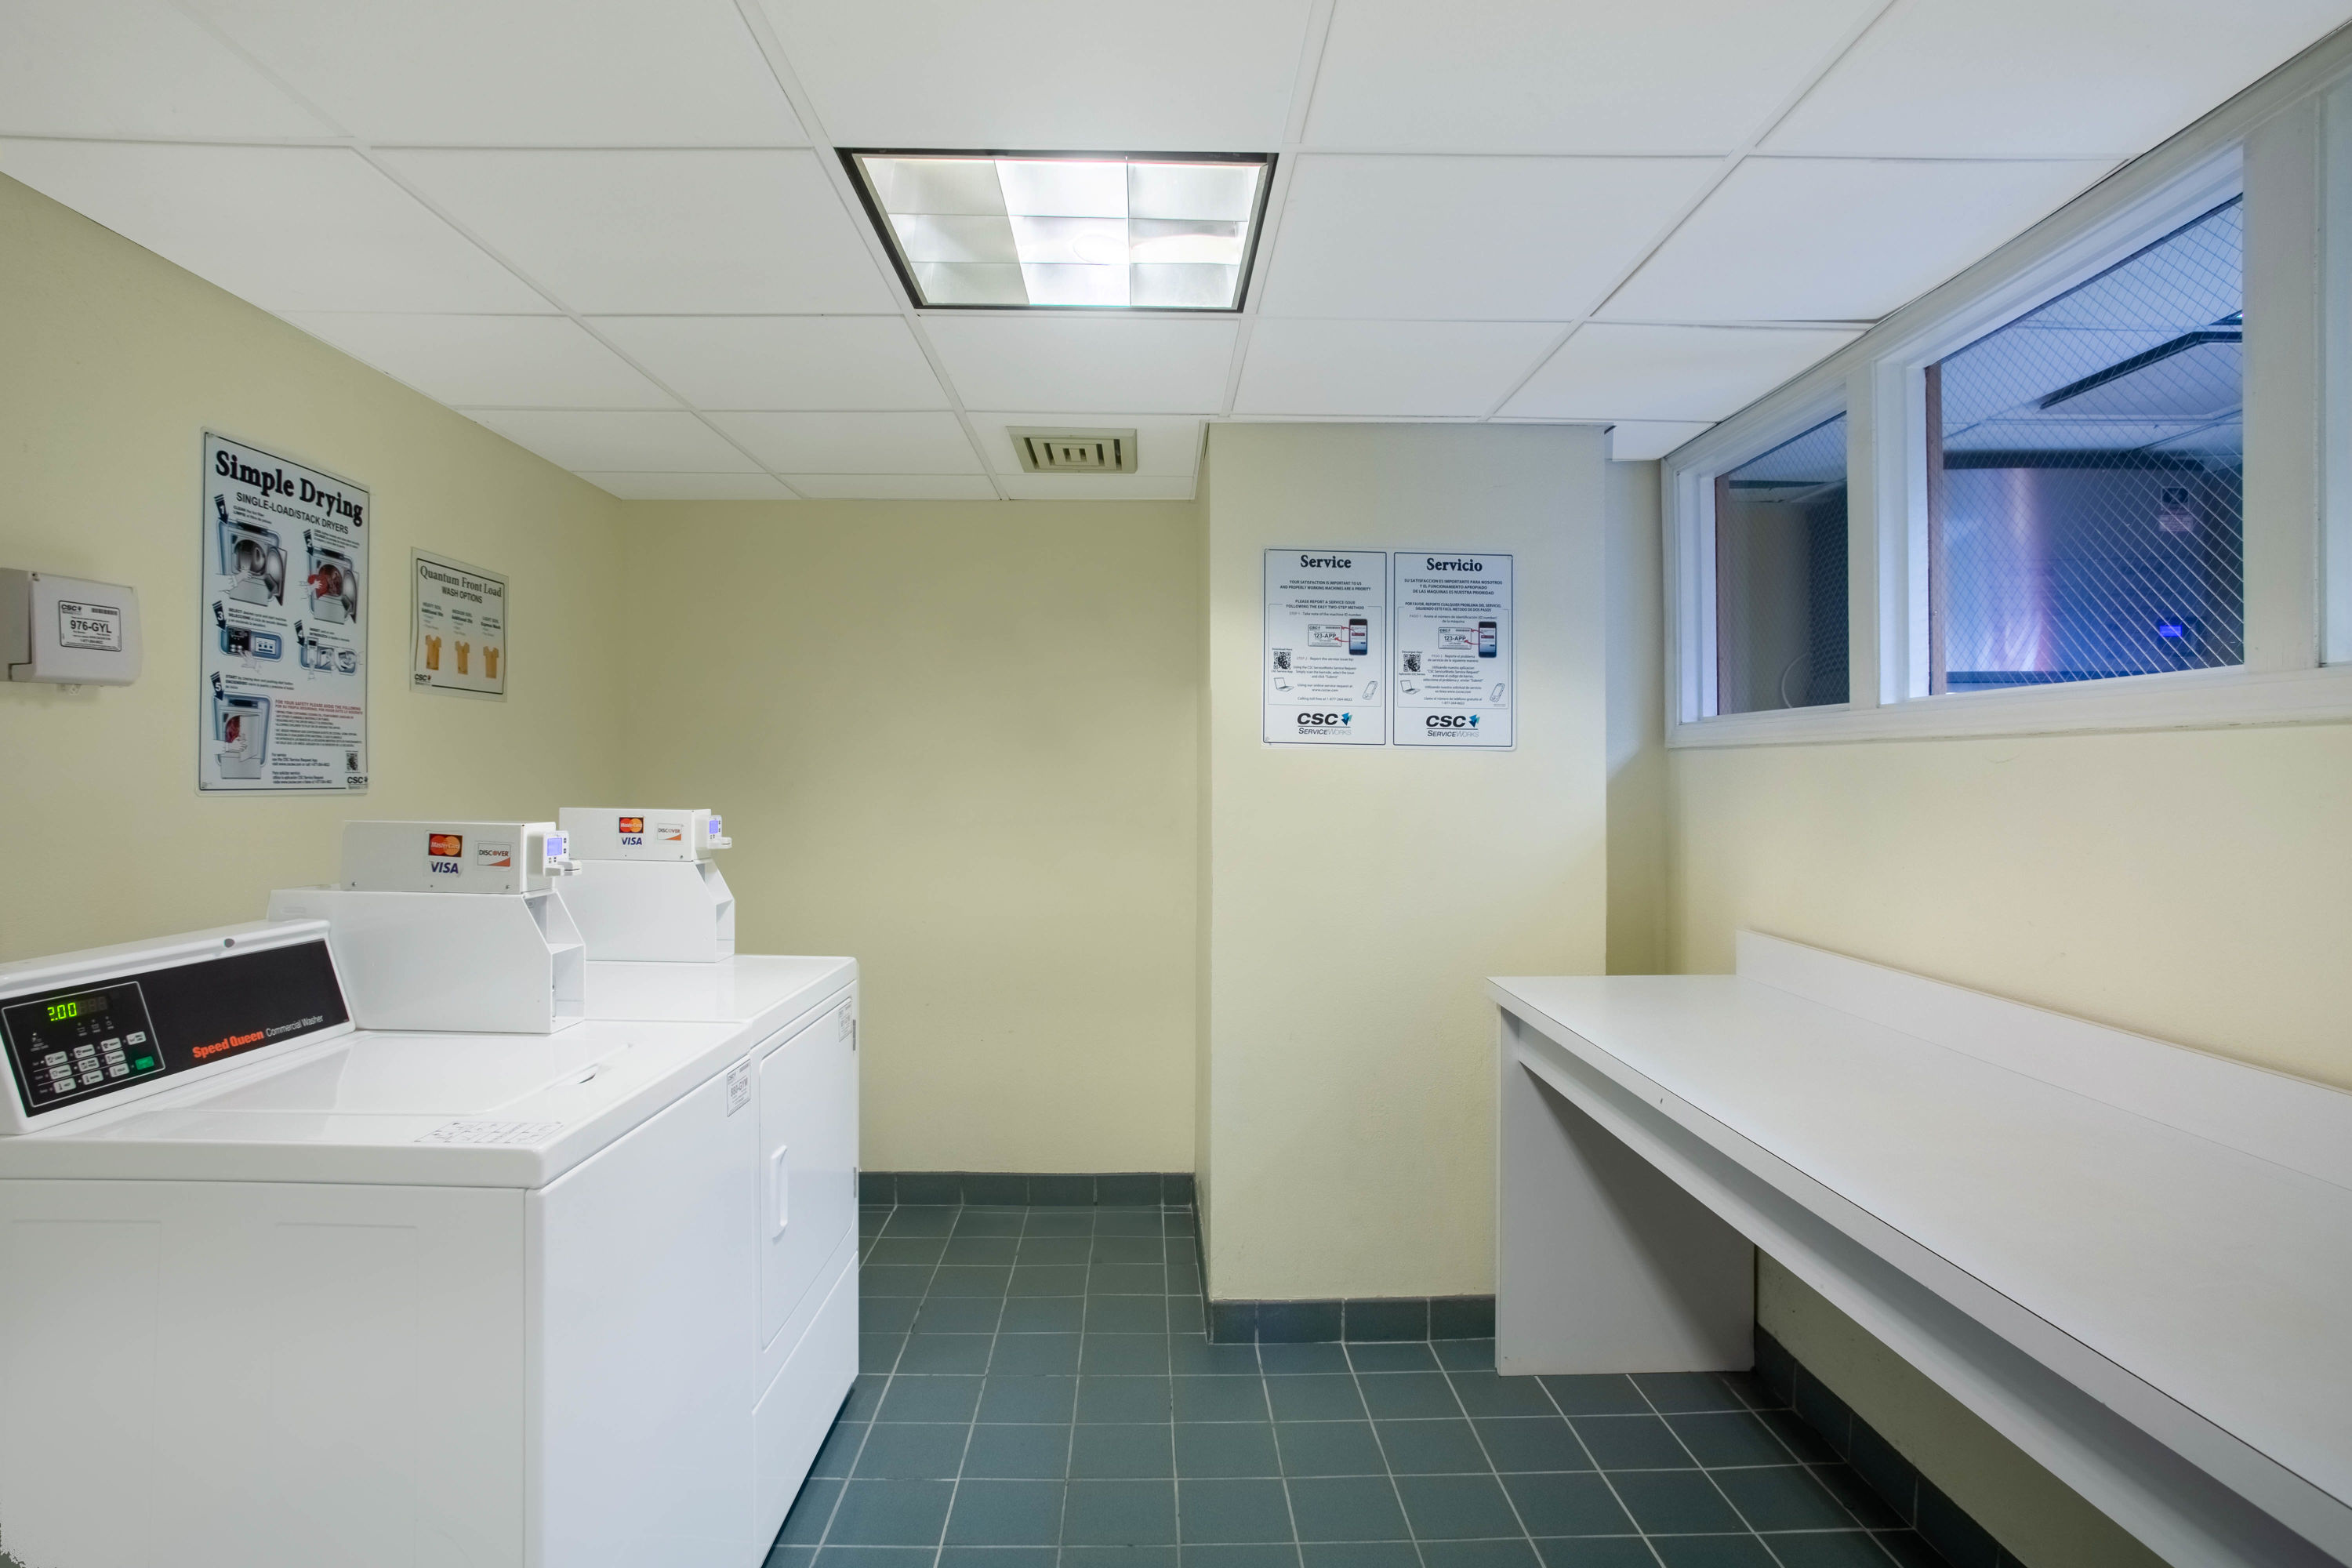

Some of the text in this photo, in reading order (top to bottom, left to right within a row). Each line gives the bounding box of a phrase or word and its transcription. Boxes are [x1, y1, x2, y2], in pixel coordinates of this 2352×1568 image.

[216, 450, 363, 528] Simple Drying
[219, 505, 226, 515] 1
[236, 492, 349, 535] SINGLE-LOAD/STACK DRYERS
[307, 539, 313, 548] 2
[1301, 554, 1352, 568] Service
[1426, 557, 1483, 572] Servicio
[420, 565, 502, 597] Quantum Front Load
[441, 586, 482, 604] WASH OPTIONS
[217, 611, 223, 621] 3
[70, 620, 112, 633] 976-GYL
[215, 682, 221, 691] 5
[1298, 713, 1339, 725] CSC
[1425, 715, 1467, 728] CSC
[622, 837, 642, 846] VISA
[430, 862, 459, 874] VISA
[192, 1014, 324, 1058] Speed Queen Commercial Washer
